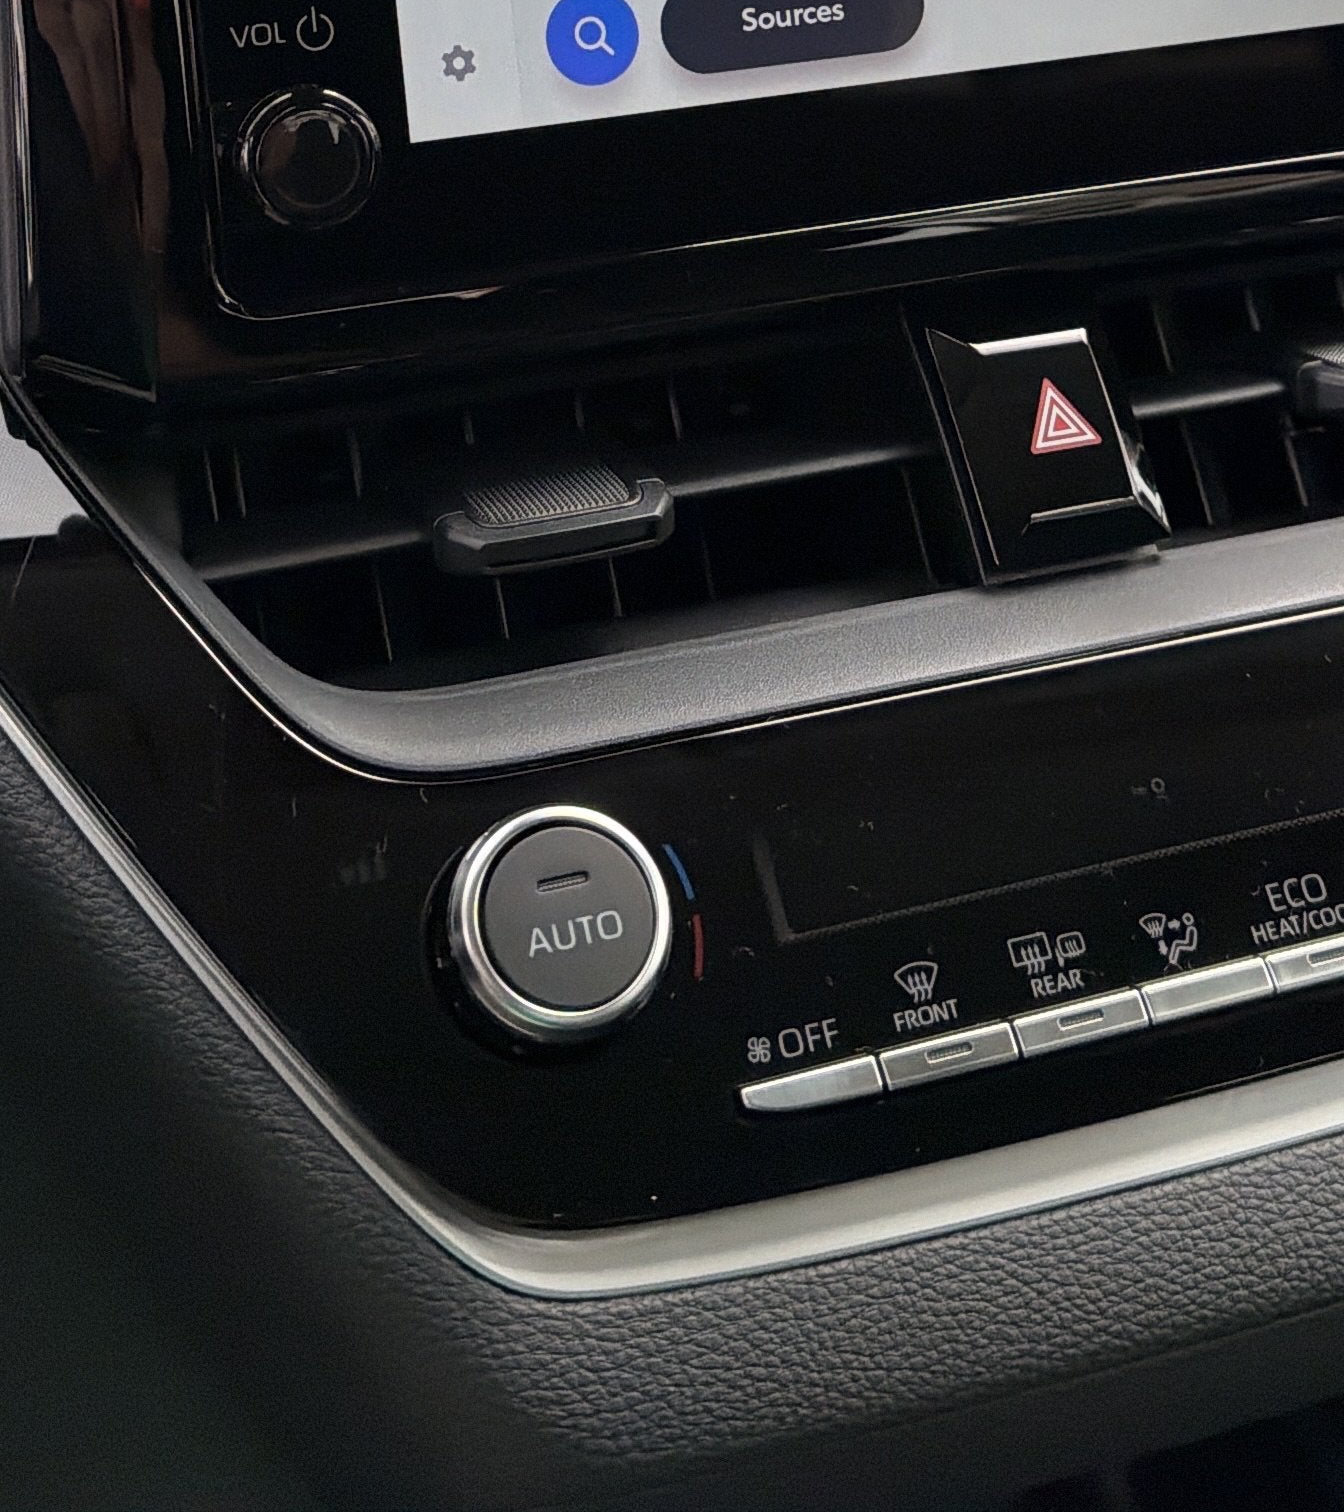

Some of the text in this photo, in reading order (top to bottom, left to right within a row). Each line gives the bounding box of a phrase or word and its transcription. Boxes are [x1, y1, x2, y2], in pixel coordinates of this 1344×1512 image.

[741, 1, 845, 32] Sources
[230, 22, 286, 48] VOL
[1264, 872, 1328, 913] ECO
[529, 910, 623, 958] AUTO
[1030, 968, 1085, 999] REAR
[893, 998, 959, 1033] FRONT
[778, 1018, 840, 1060] OFF
